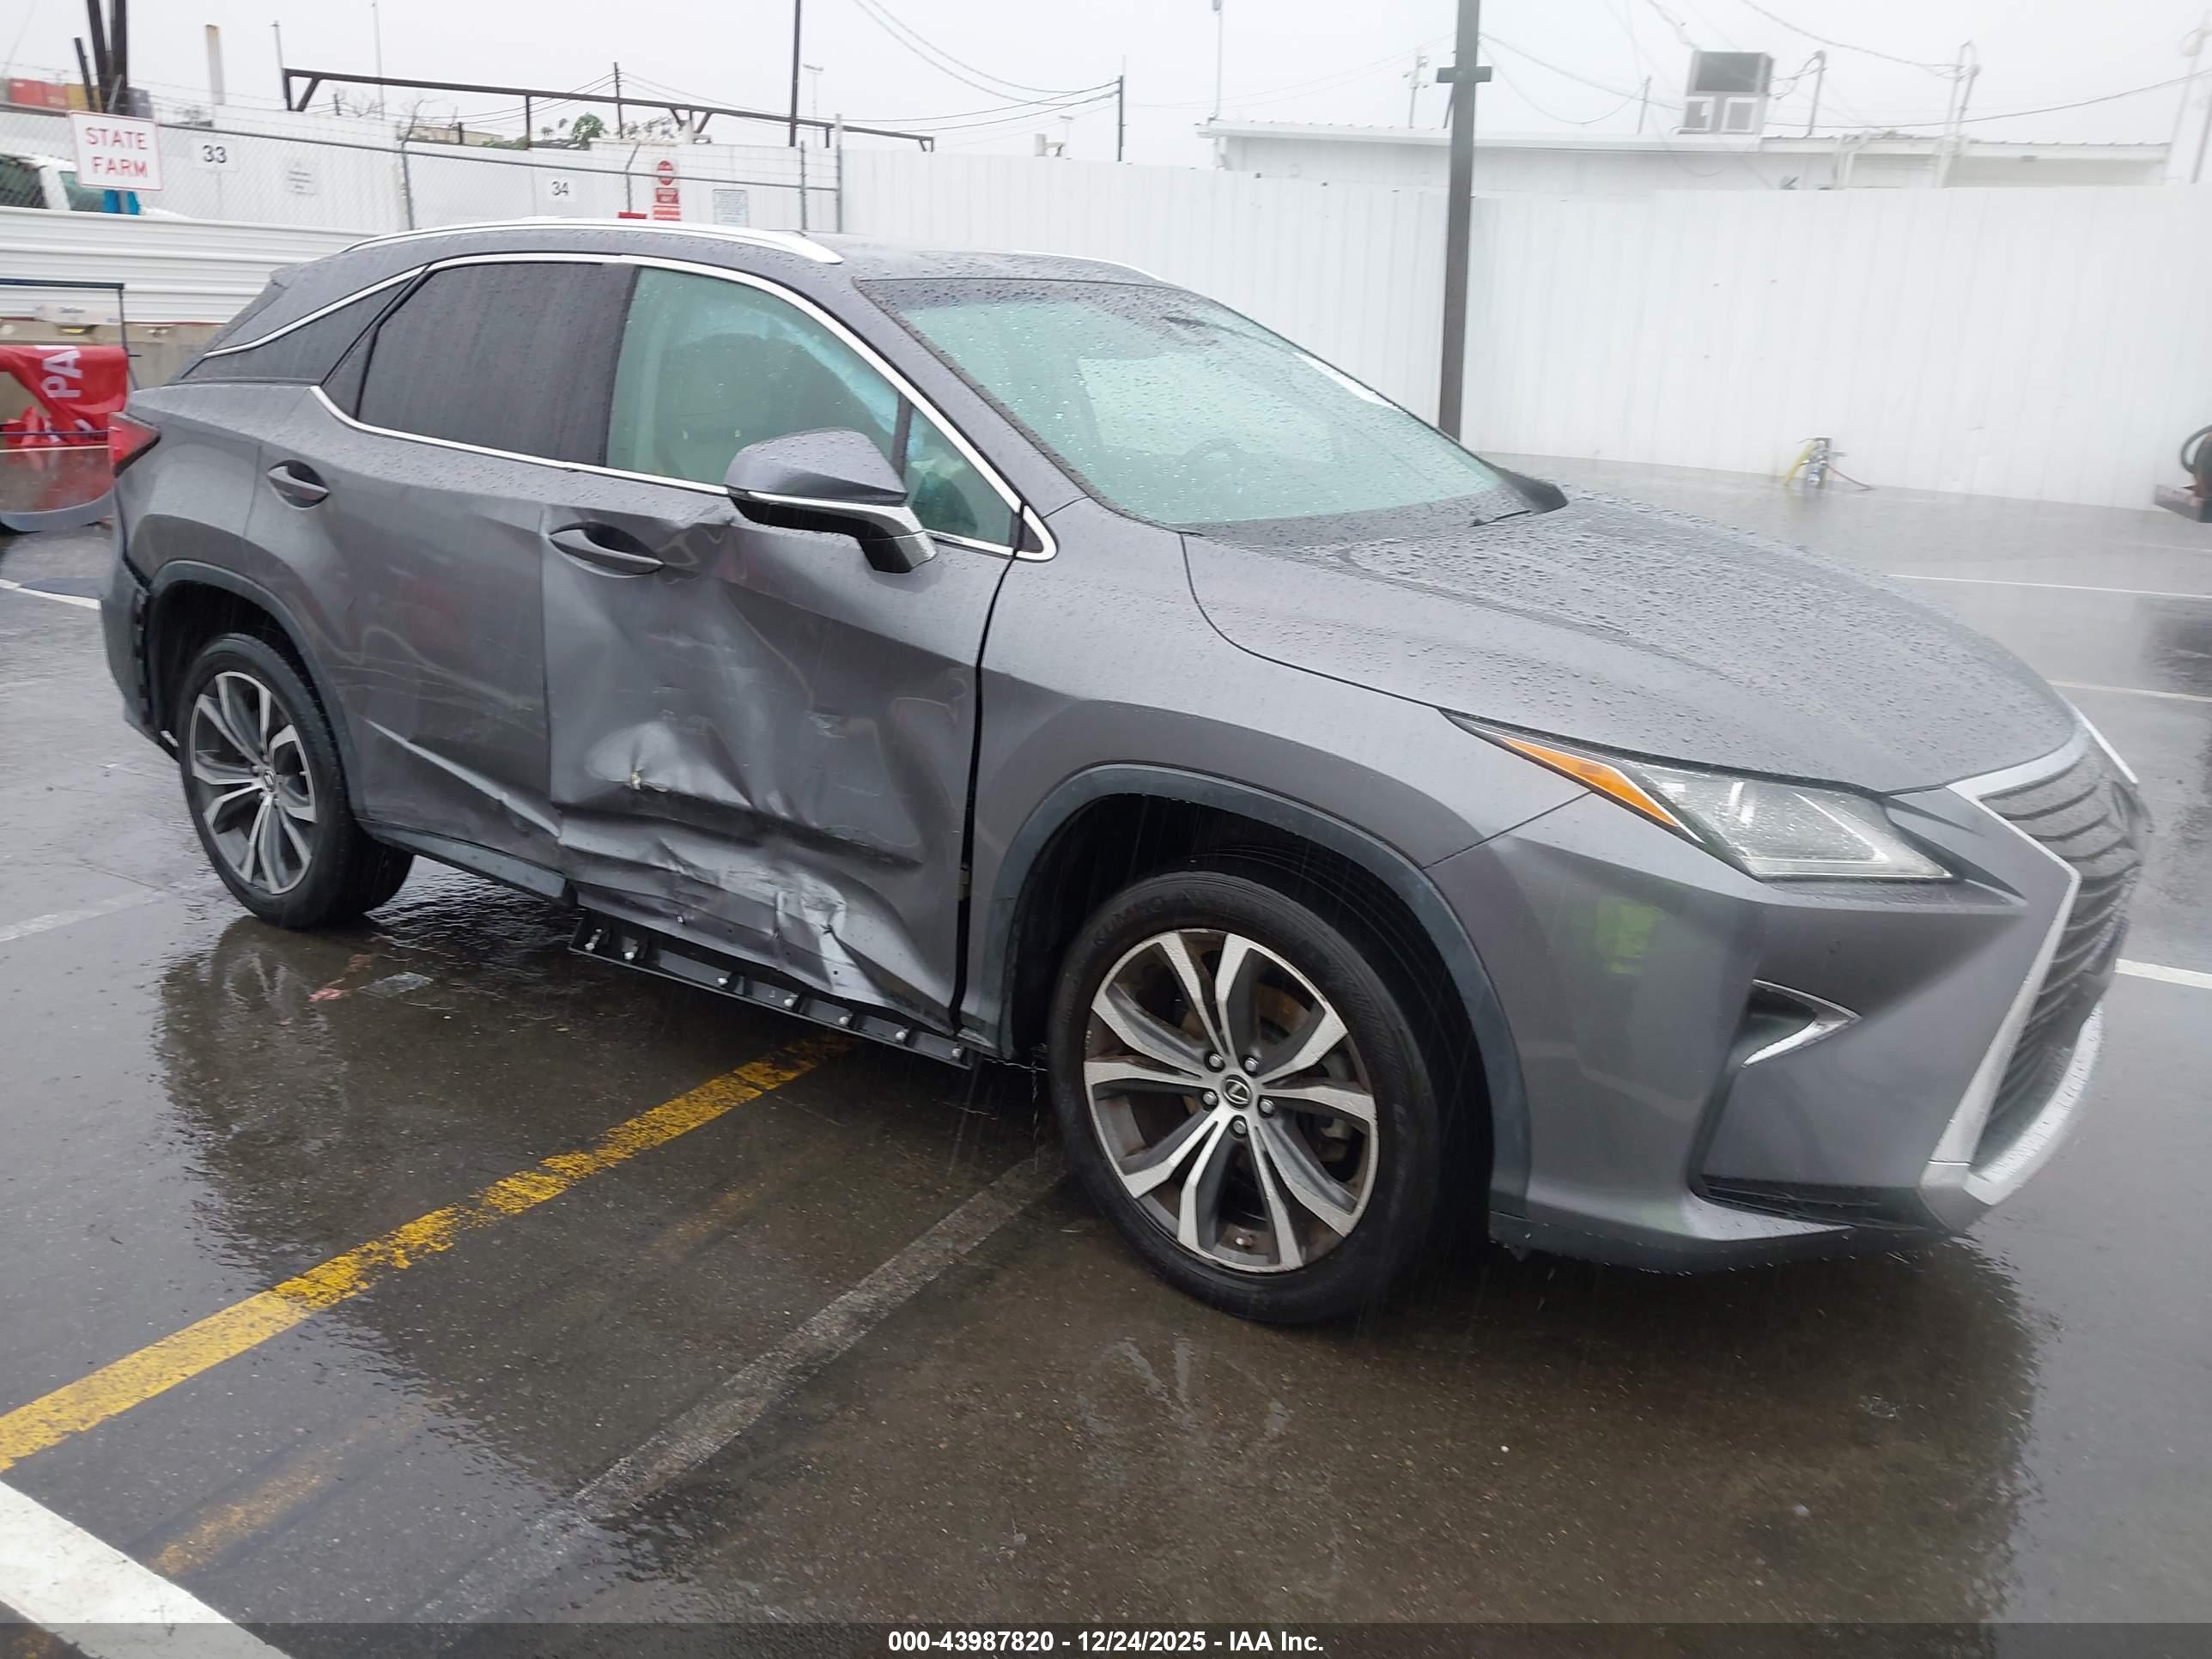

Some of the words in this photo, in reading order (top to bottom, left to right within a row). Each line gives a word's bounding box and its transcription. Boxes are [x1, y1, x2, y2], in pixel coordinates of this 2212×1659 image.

[85, 127, 148, 150] STATE
[202, 144, 228, 164] 33
[92, 155, 149, 178] FARM
[550, 180, 570, 197] 34
